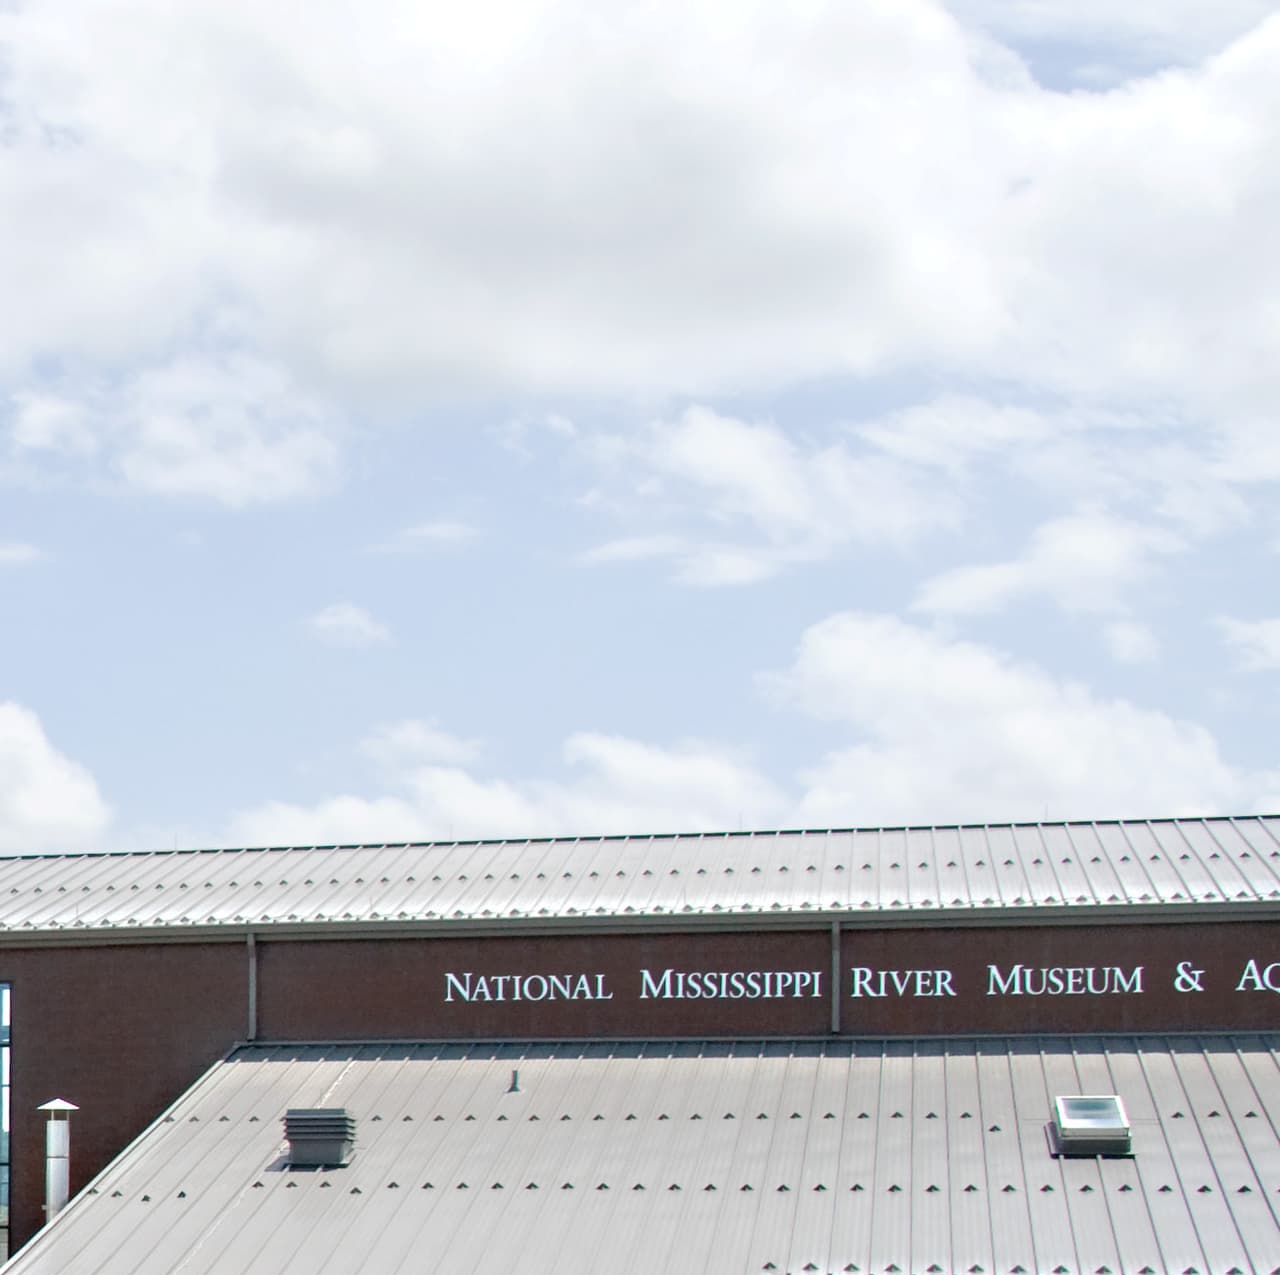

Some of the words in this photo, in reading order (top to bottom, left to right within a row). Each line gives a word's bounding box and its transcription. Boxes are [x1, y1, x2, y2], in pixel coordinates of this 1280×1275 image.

[444, 972, 613, 1002] NATIONAL
[639, 968, 822, 999] MISSISSIPPI
[850, 967, 957, 998] RIVER
[986, 964, 1144, 996] MUSEUM
[1173, 961, 1206, 993] &
